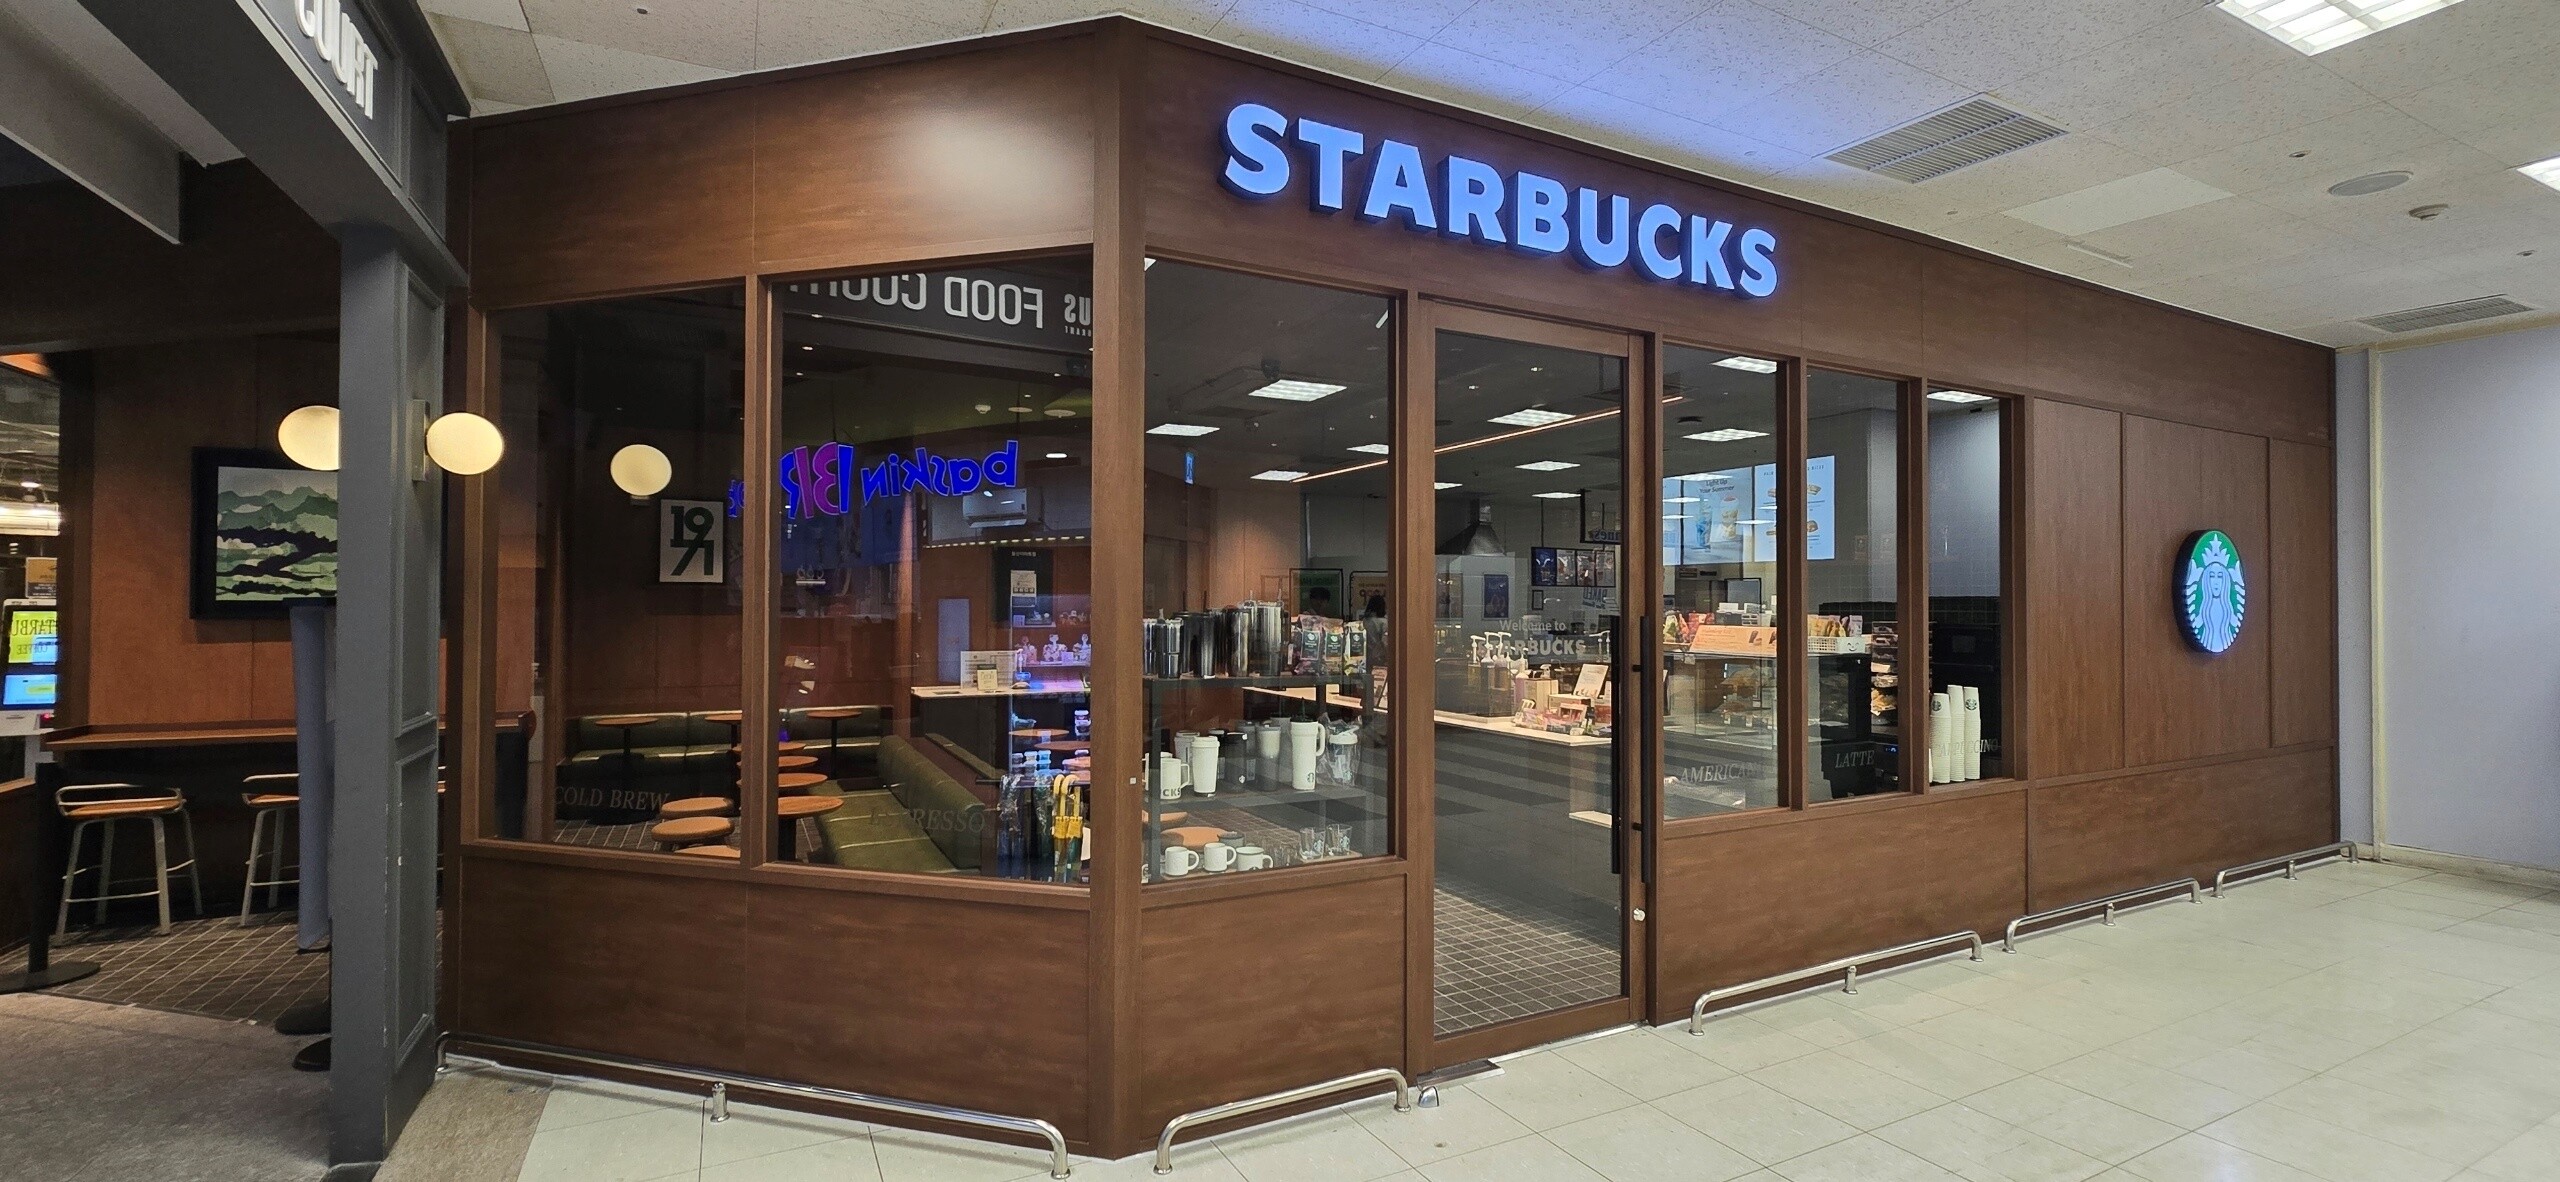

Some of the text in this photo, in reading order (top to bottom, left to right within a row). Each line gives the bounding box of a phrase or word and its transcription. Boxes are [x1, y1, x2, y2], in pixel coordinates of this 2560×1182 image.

[1222, 103, 1779, 298] STARBUCKS
[1500, 620, 1567, 631] Welcome to
[1834, 750, 1875, 769] LATTE
[1679, 761, 1763, 784] AMERICA
[554, 786, 671, 811] COLD BREW
